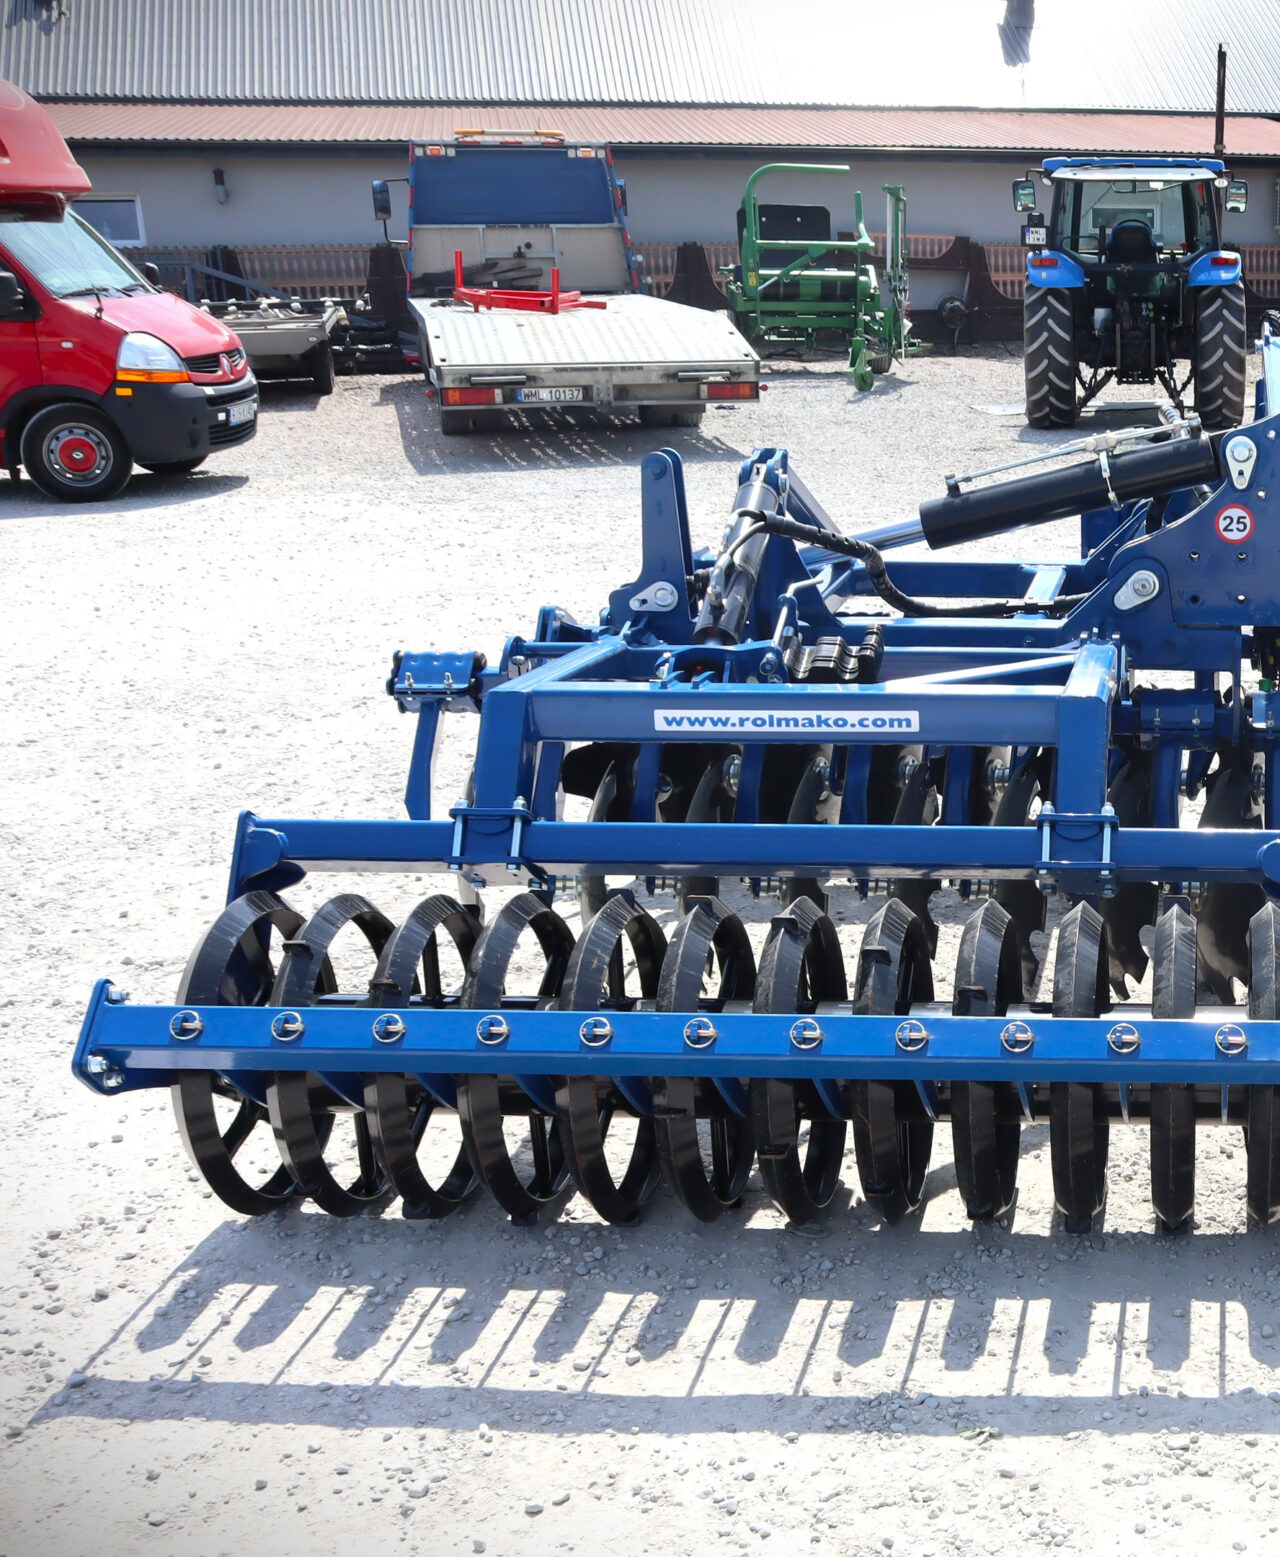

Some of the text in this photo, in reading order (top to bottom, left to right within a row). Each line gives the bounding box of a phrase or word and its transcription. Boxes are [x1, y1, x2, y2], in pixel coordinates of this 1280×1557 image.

[523, 388, 580, 400] WML 10137
[1222, 515, 1248, 532] 25
[663, 714, 912, 728] www.rolmako.com
